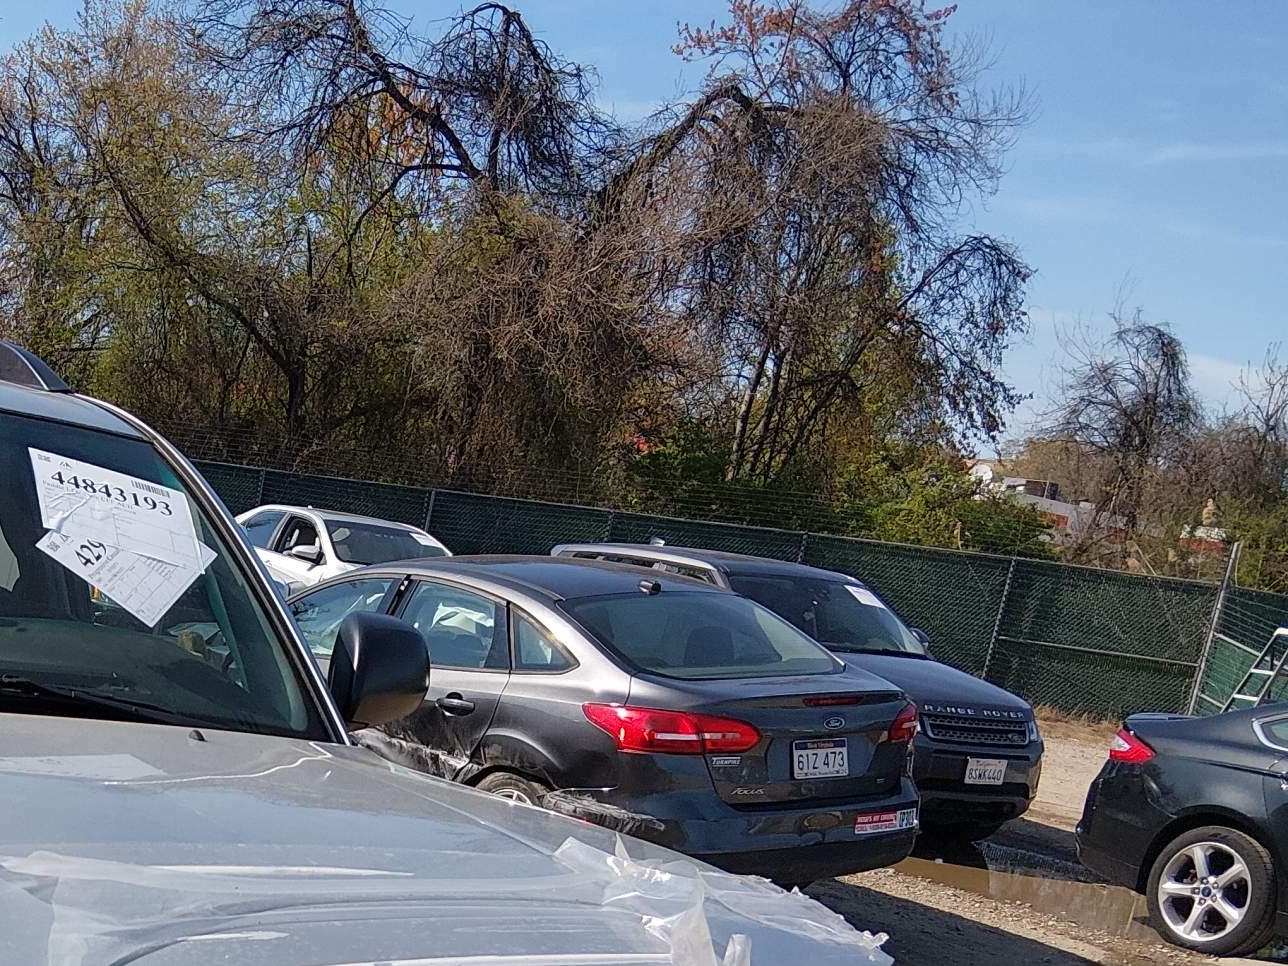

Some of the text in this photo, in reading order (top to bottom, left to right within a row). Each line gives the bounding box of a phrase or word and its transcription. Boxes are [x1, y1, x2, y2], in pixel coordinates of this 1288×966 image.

[50, 471, 173, 517] 44843193
[924, 704, 1025, 719] RANGE ROVER
[797, 751, 845, 771] 61Z 473
